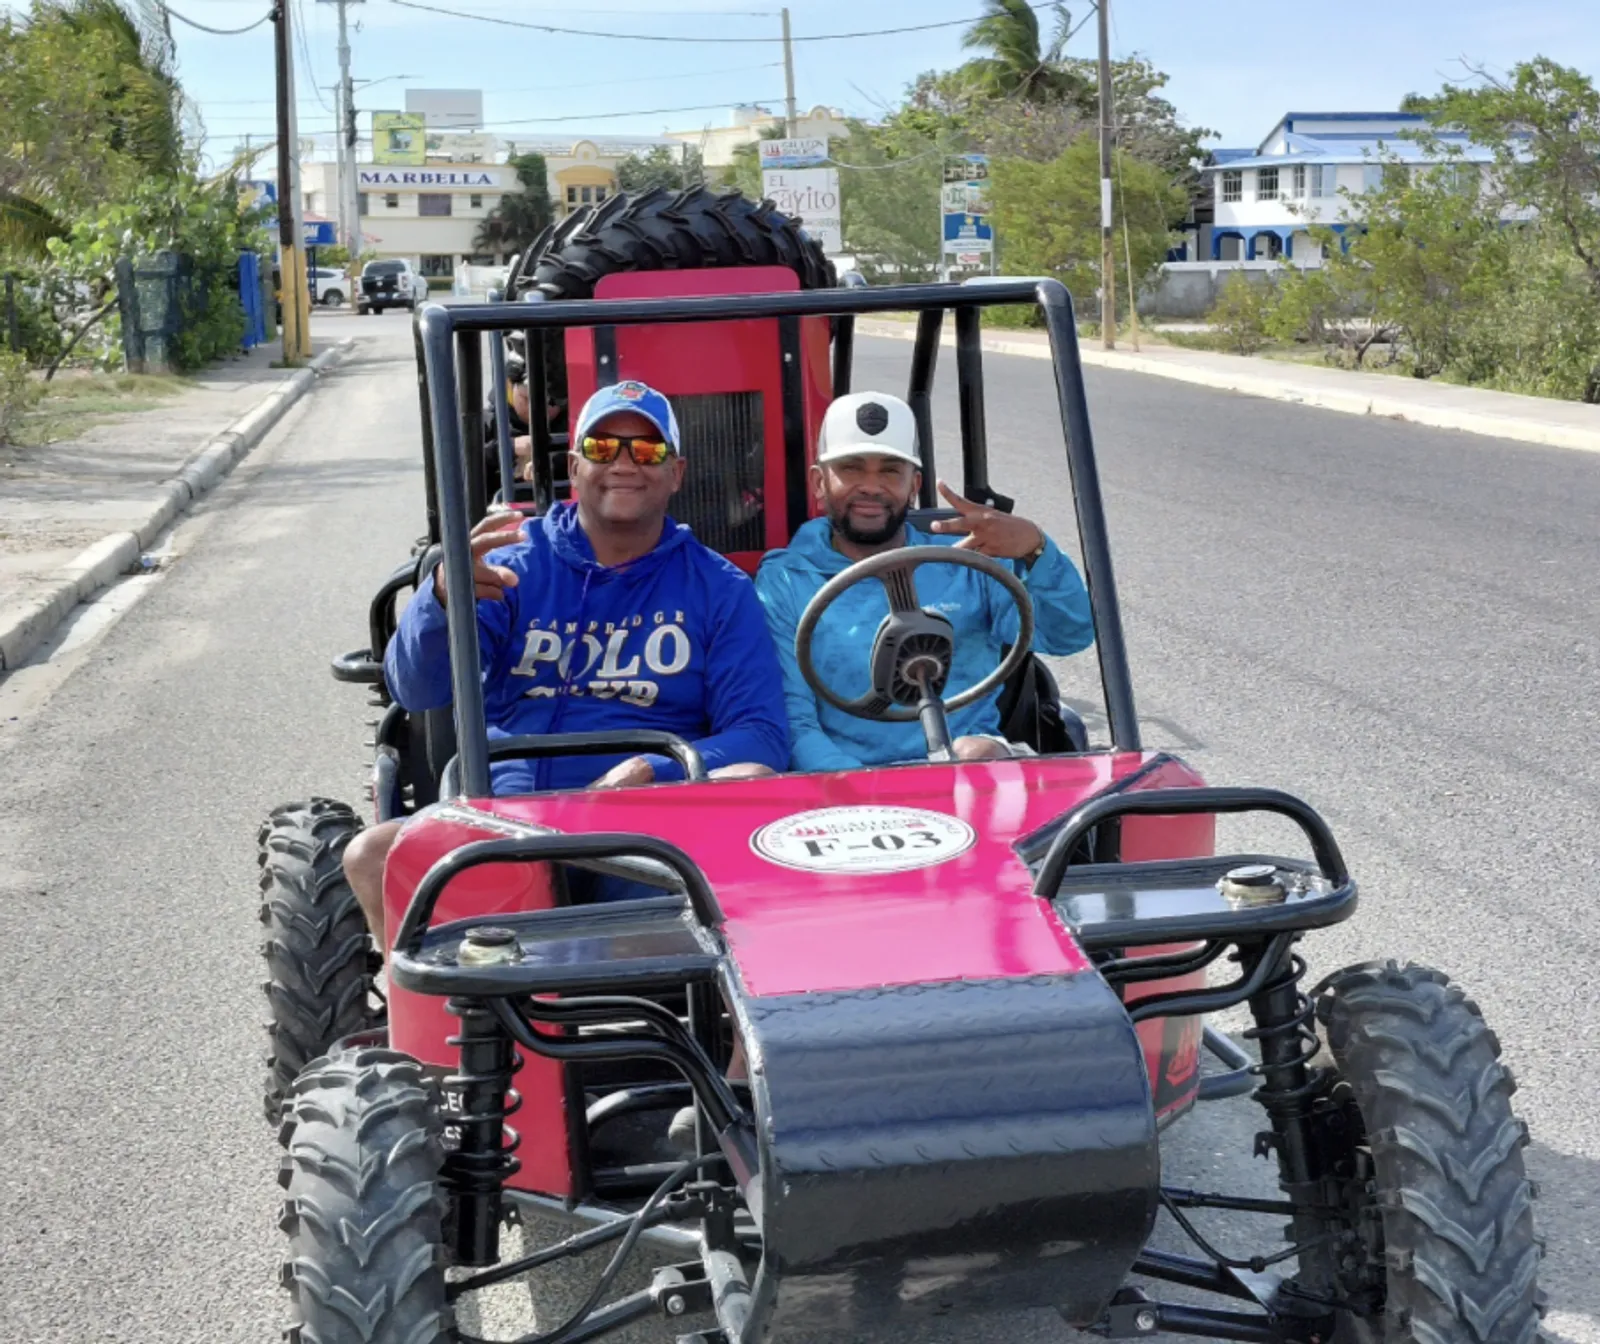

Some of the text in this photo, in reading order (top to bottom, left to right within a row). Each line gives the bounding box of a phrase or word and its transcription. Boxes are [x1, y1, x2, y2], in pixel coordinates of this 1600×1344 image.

[360, 172, 493, 185] MARBELLA
[769, 175, 786, 186] EL
[510, 624, 691, 680] POLO
[801, 831, 942, 857] F-03
